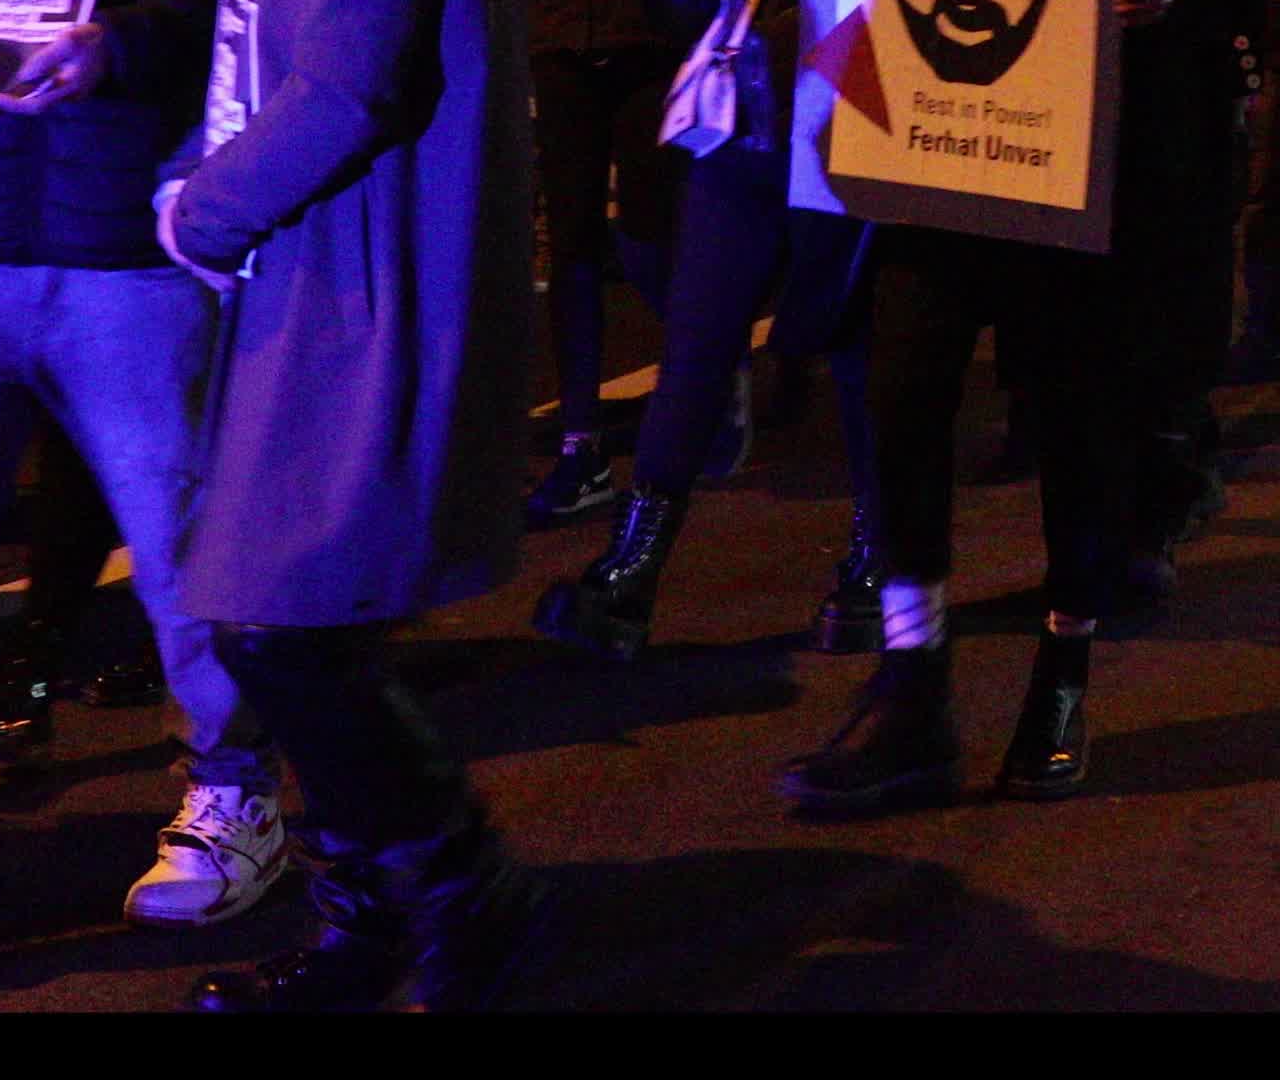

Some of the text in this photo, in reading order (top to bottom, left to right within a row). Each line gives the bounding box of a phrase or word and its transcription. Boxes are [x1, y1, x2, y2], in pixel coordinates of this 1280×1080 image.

[912, 91, 1052, 127] Rest in Power!
[908, 125, 1053, 166] Ferhat Unvar
